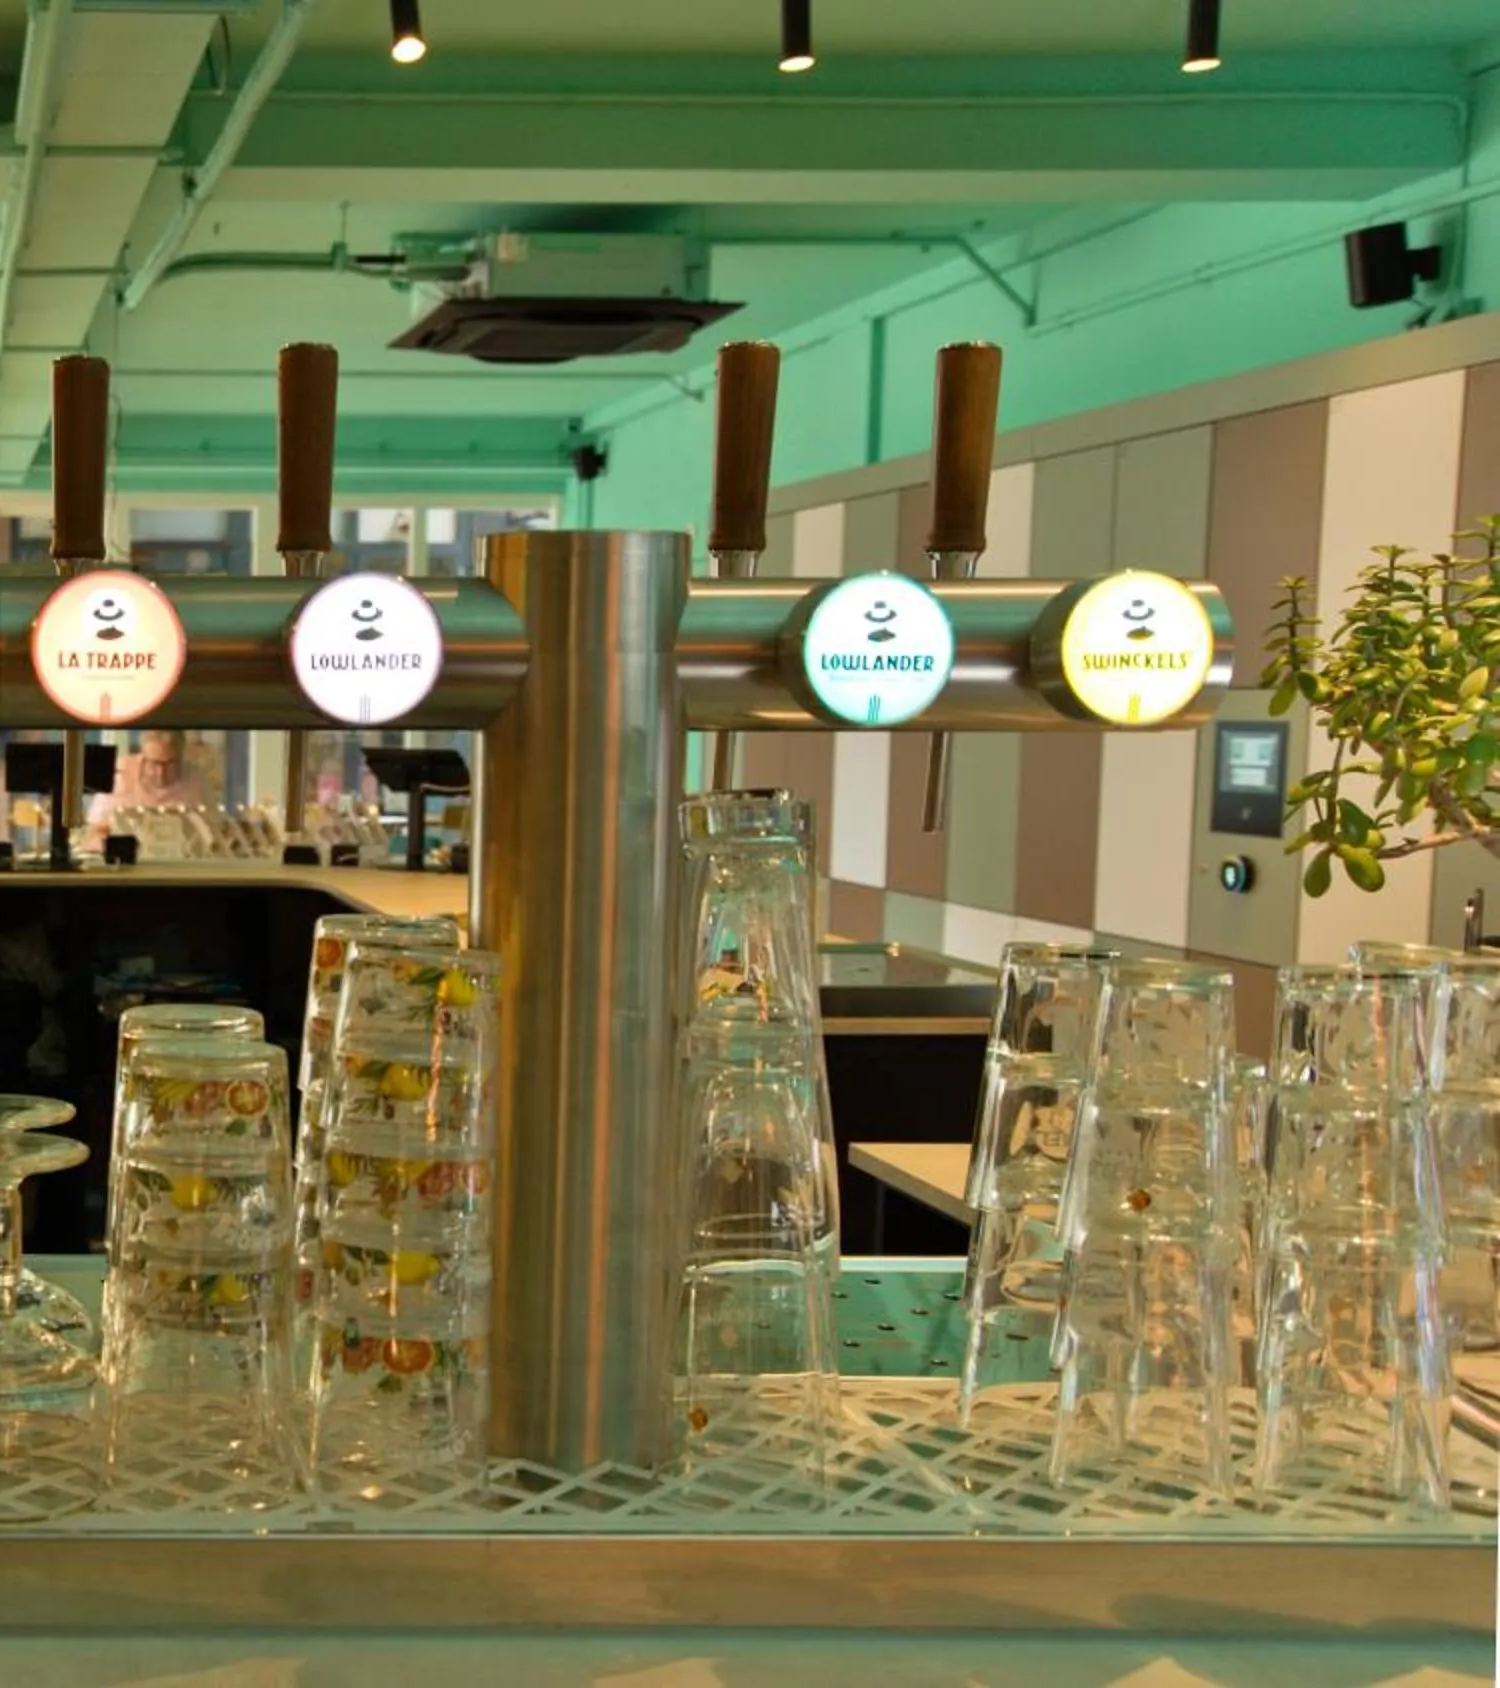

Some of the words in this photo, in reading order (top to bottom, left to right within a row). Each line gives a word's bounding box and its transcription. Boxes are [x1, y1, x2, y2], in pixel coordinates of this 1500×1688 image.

[58, 652, 79, 669] LA
[87, 652, 157, 670] TRAPPE
[310, 653, 422, 670] LOWLANDER
[821, 654, 934, 672] LOWLANDER
